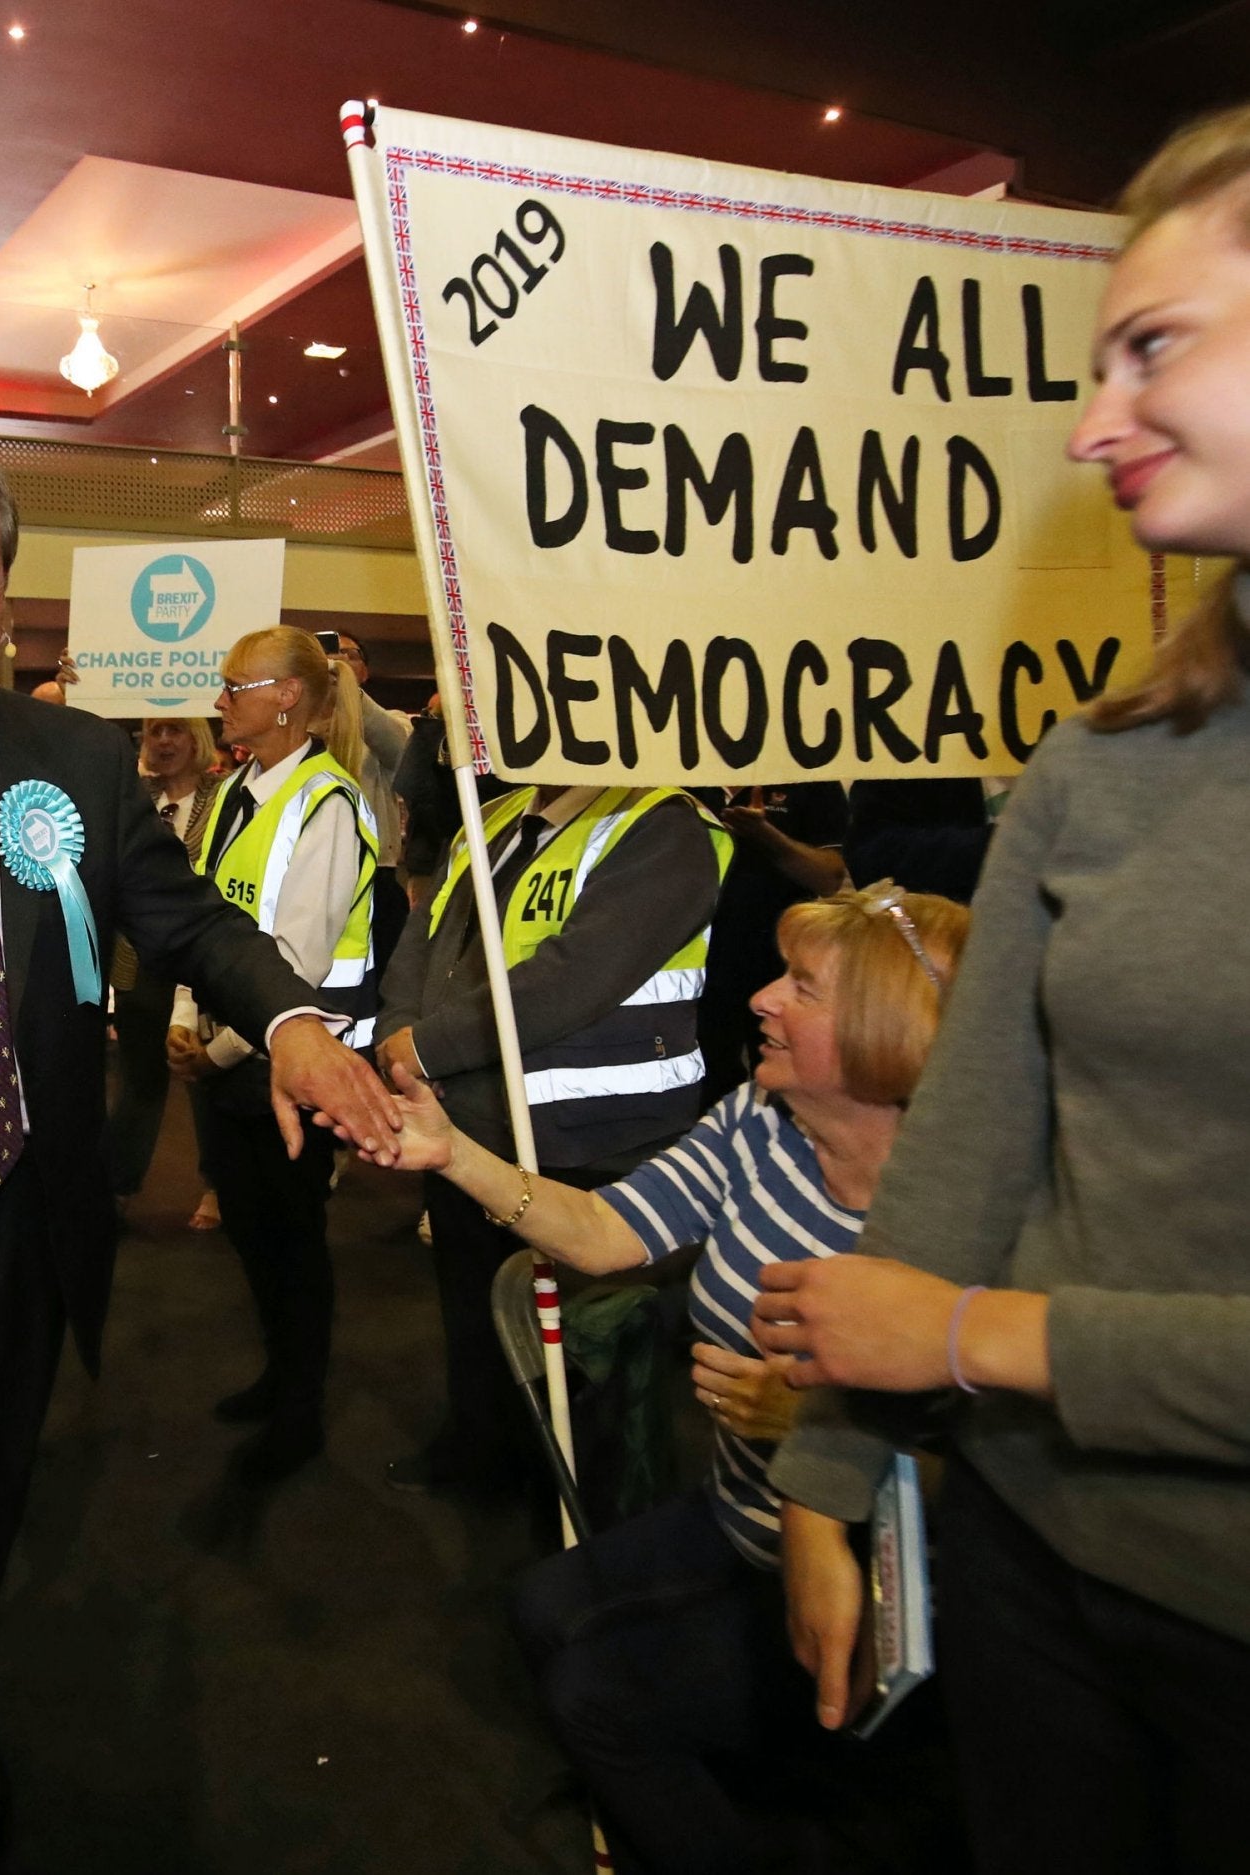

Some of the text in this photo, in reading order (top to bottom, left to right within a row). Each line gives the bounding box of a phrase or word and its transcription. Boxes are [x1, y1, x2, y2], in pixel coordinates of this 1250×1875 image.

[442, 199, 567, 348] 2019
[649, 242, 1079, 403] WE ALL
[519, 404, 1003, 565] DEMAND
[156, 604, 191, 618] PARTY
[157, 592, 199, 604] BREXIT
[76, 652, 162, 668] CHANGE
[112, 671, 224, 688] FOR GOOD
[487, 621, 1121, 771] DEMOCRACY
[226, 878, 256, 904] 515
[521, 868, 573, 922] 247
